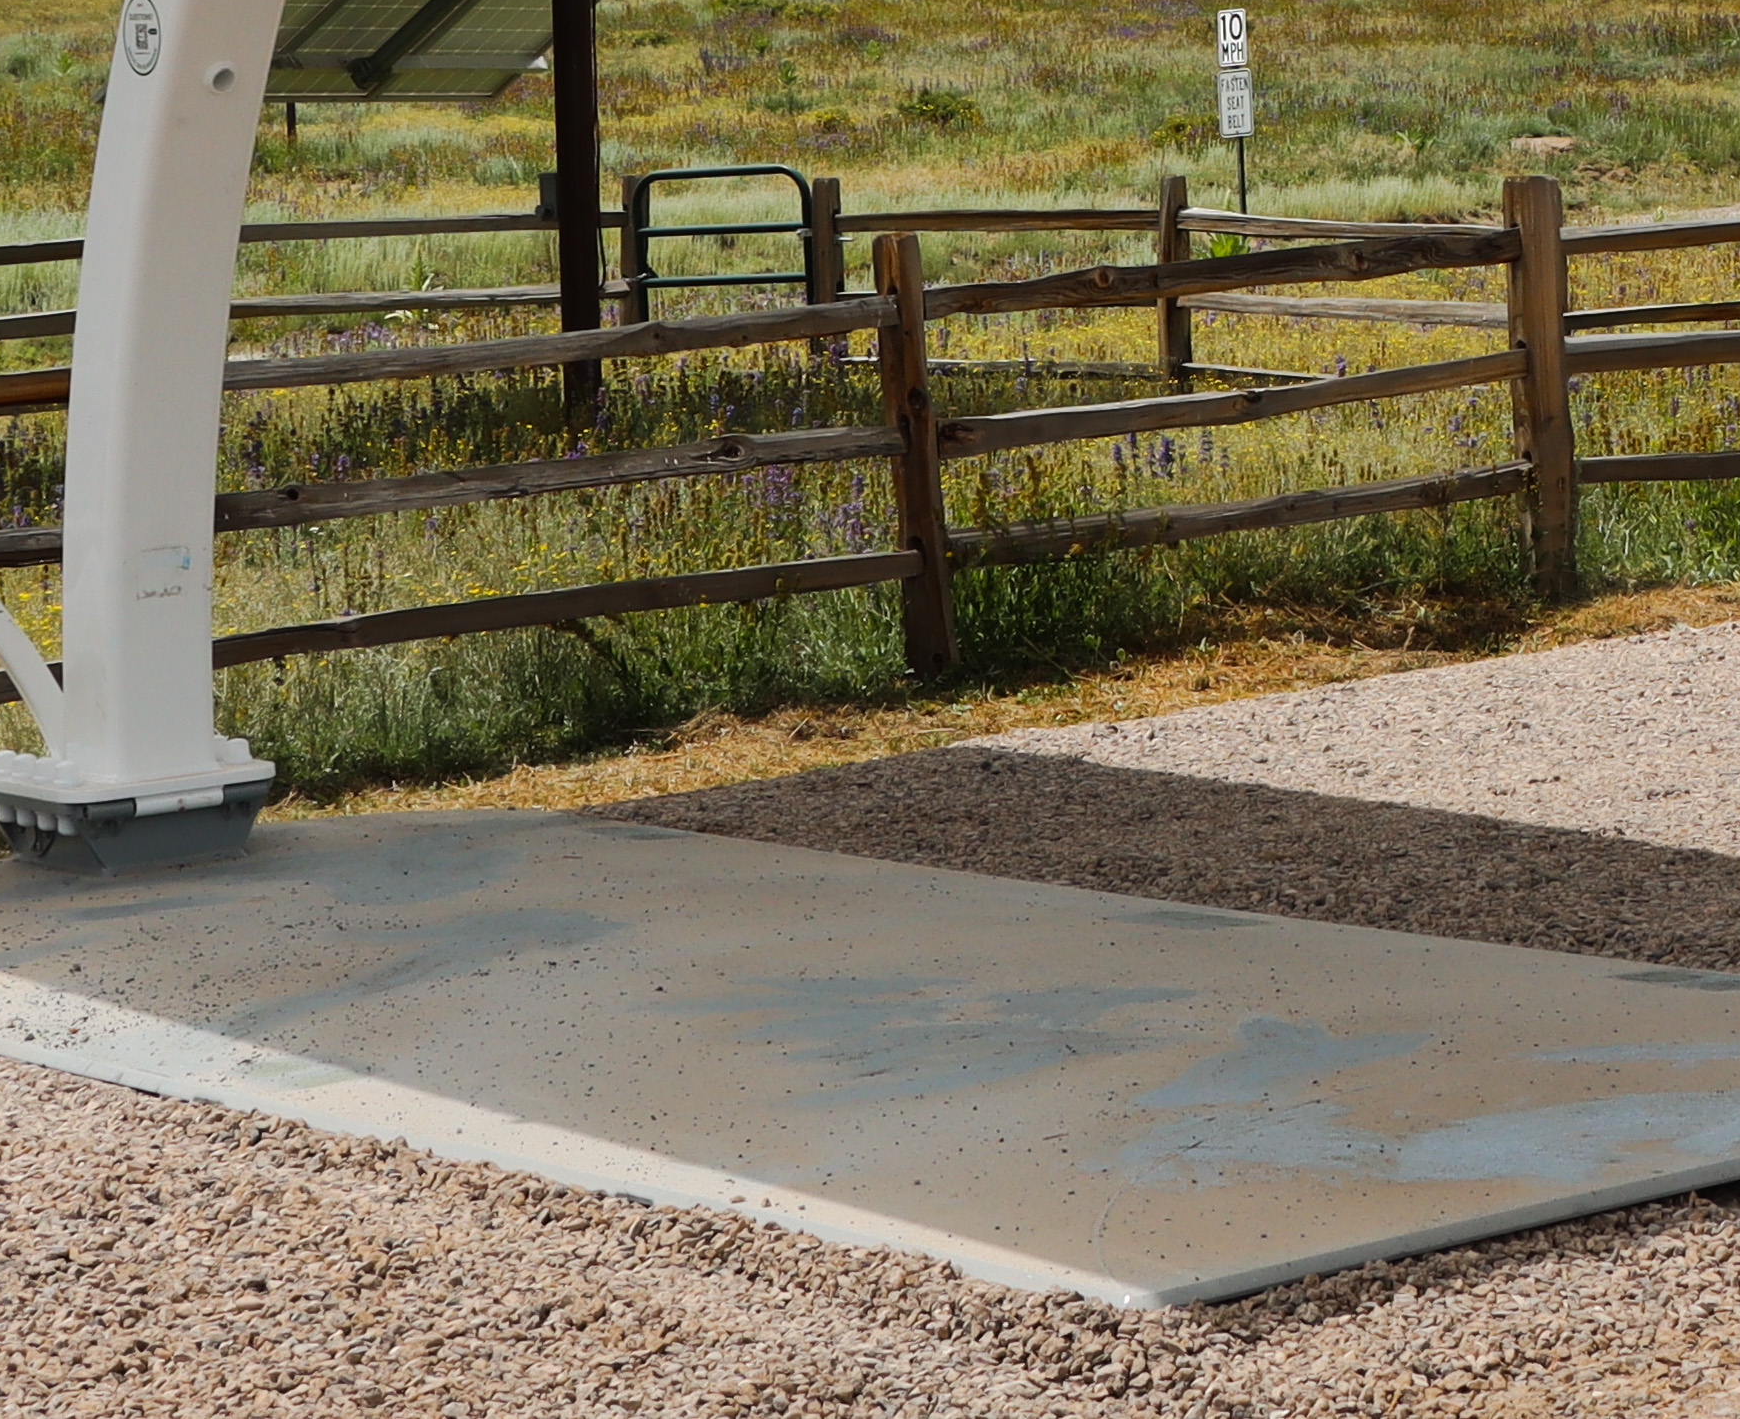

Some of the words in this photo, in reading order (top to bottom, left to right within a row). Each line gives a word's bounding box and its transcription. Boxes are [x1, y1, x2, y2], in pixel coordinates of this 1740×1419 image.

[1221, 13, 1243, 41] 10
[1222, 42, 1244, 61] MPH
[1221, 77, 1248, 92] FASTEN
[1227, 96, 1244, 110] SEAT
[1228, 114, 1244, 129] BELT
